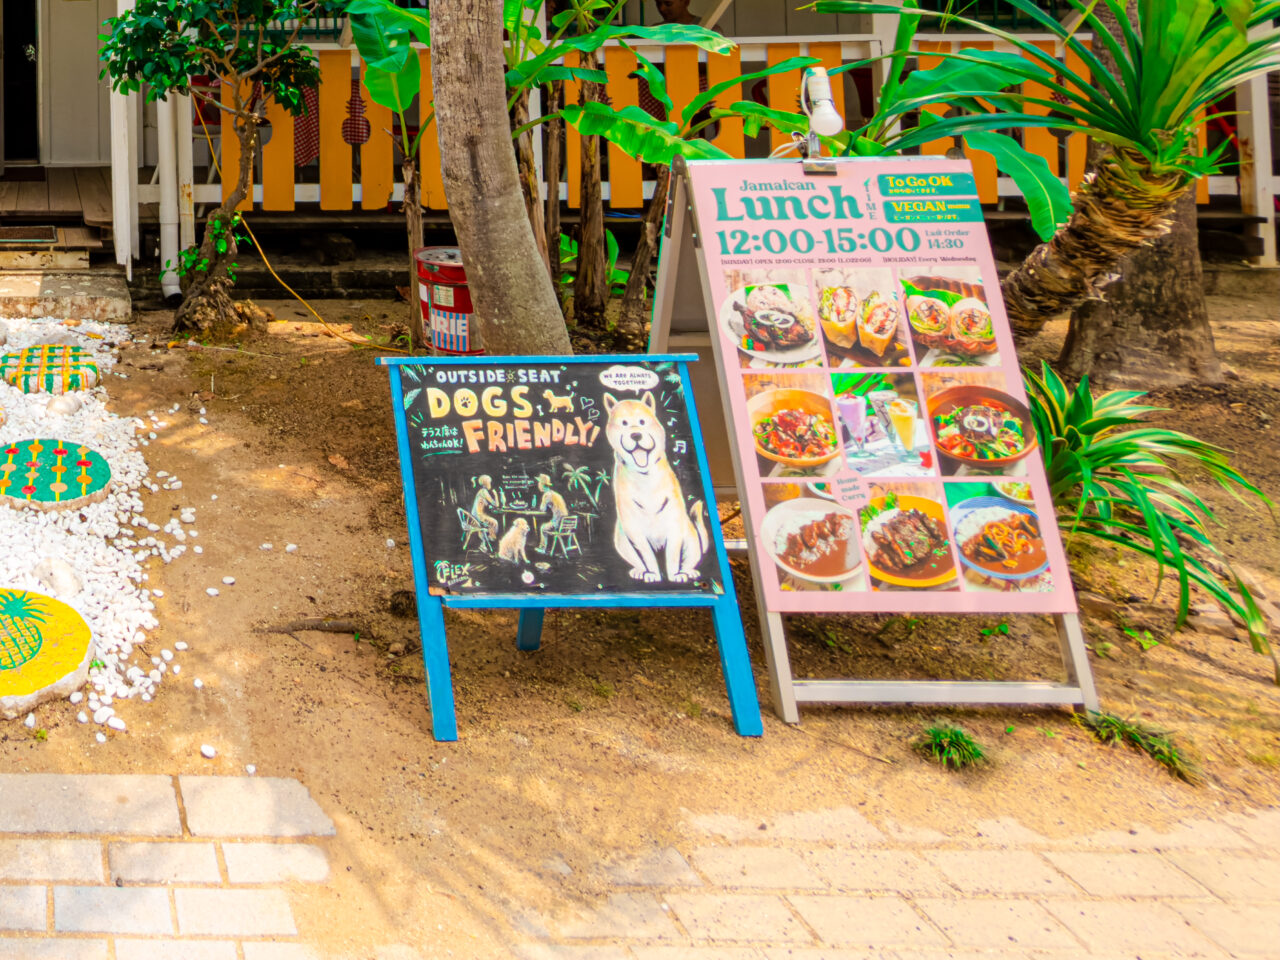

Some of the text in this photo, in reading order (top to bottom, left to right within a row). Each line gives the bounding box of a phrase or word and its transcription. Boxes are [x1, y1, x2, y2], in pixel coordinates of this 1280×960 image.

[739, 180, 816, 192] Jamaican
[885, 175, 954, 187] To Go OK
[710, 185, 865, 222] Lunch
[891, 201, 947, 212] VEGAN
[943, 228, 970, 236] Order
[715, 227, 921, 255] 12:00-15:00
[927, 238, 964, 250] 14:30
[431, 314, 468, 336] IRIE
[436, 369, 561, 384] OUTSIDE SEAT
[426, 385, 533, 418] DOGS
[461, 417, 601, 454] FRIENDLY!
